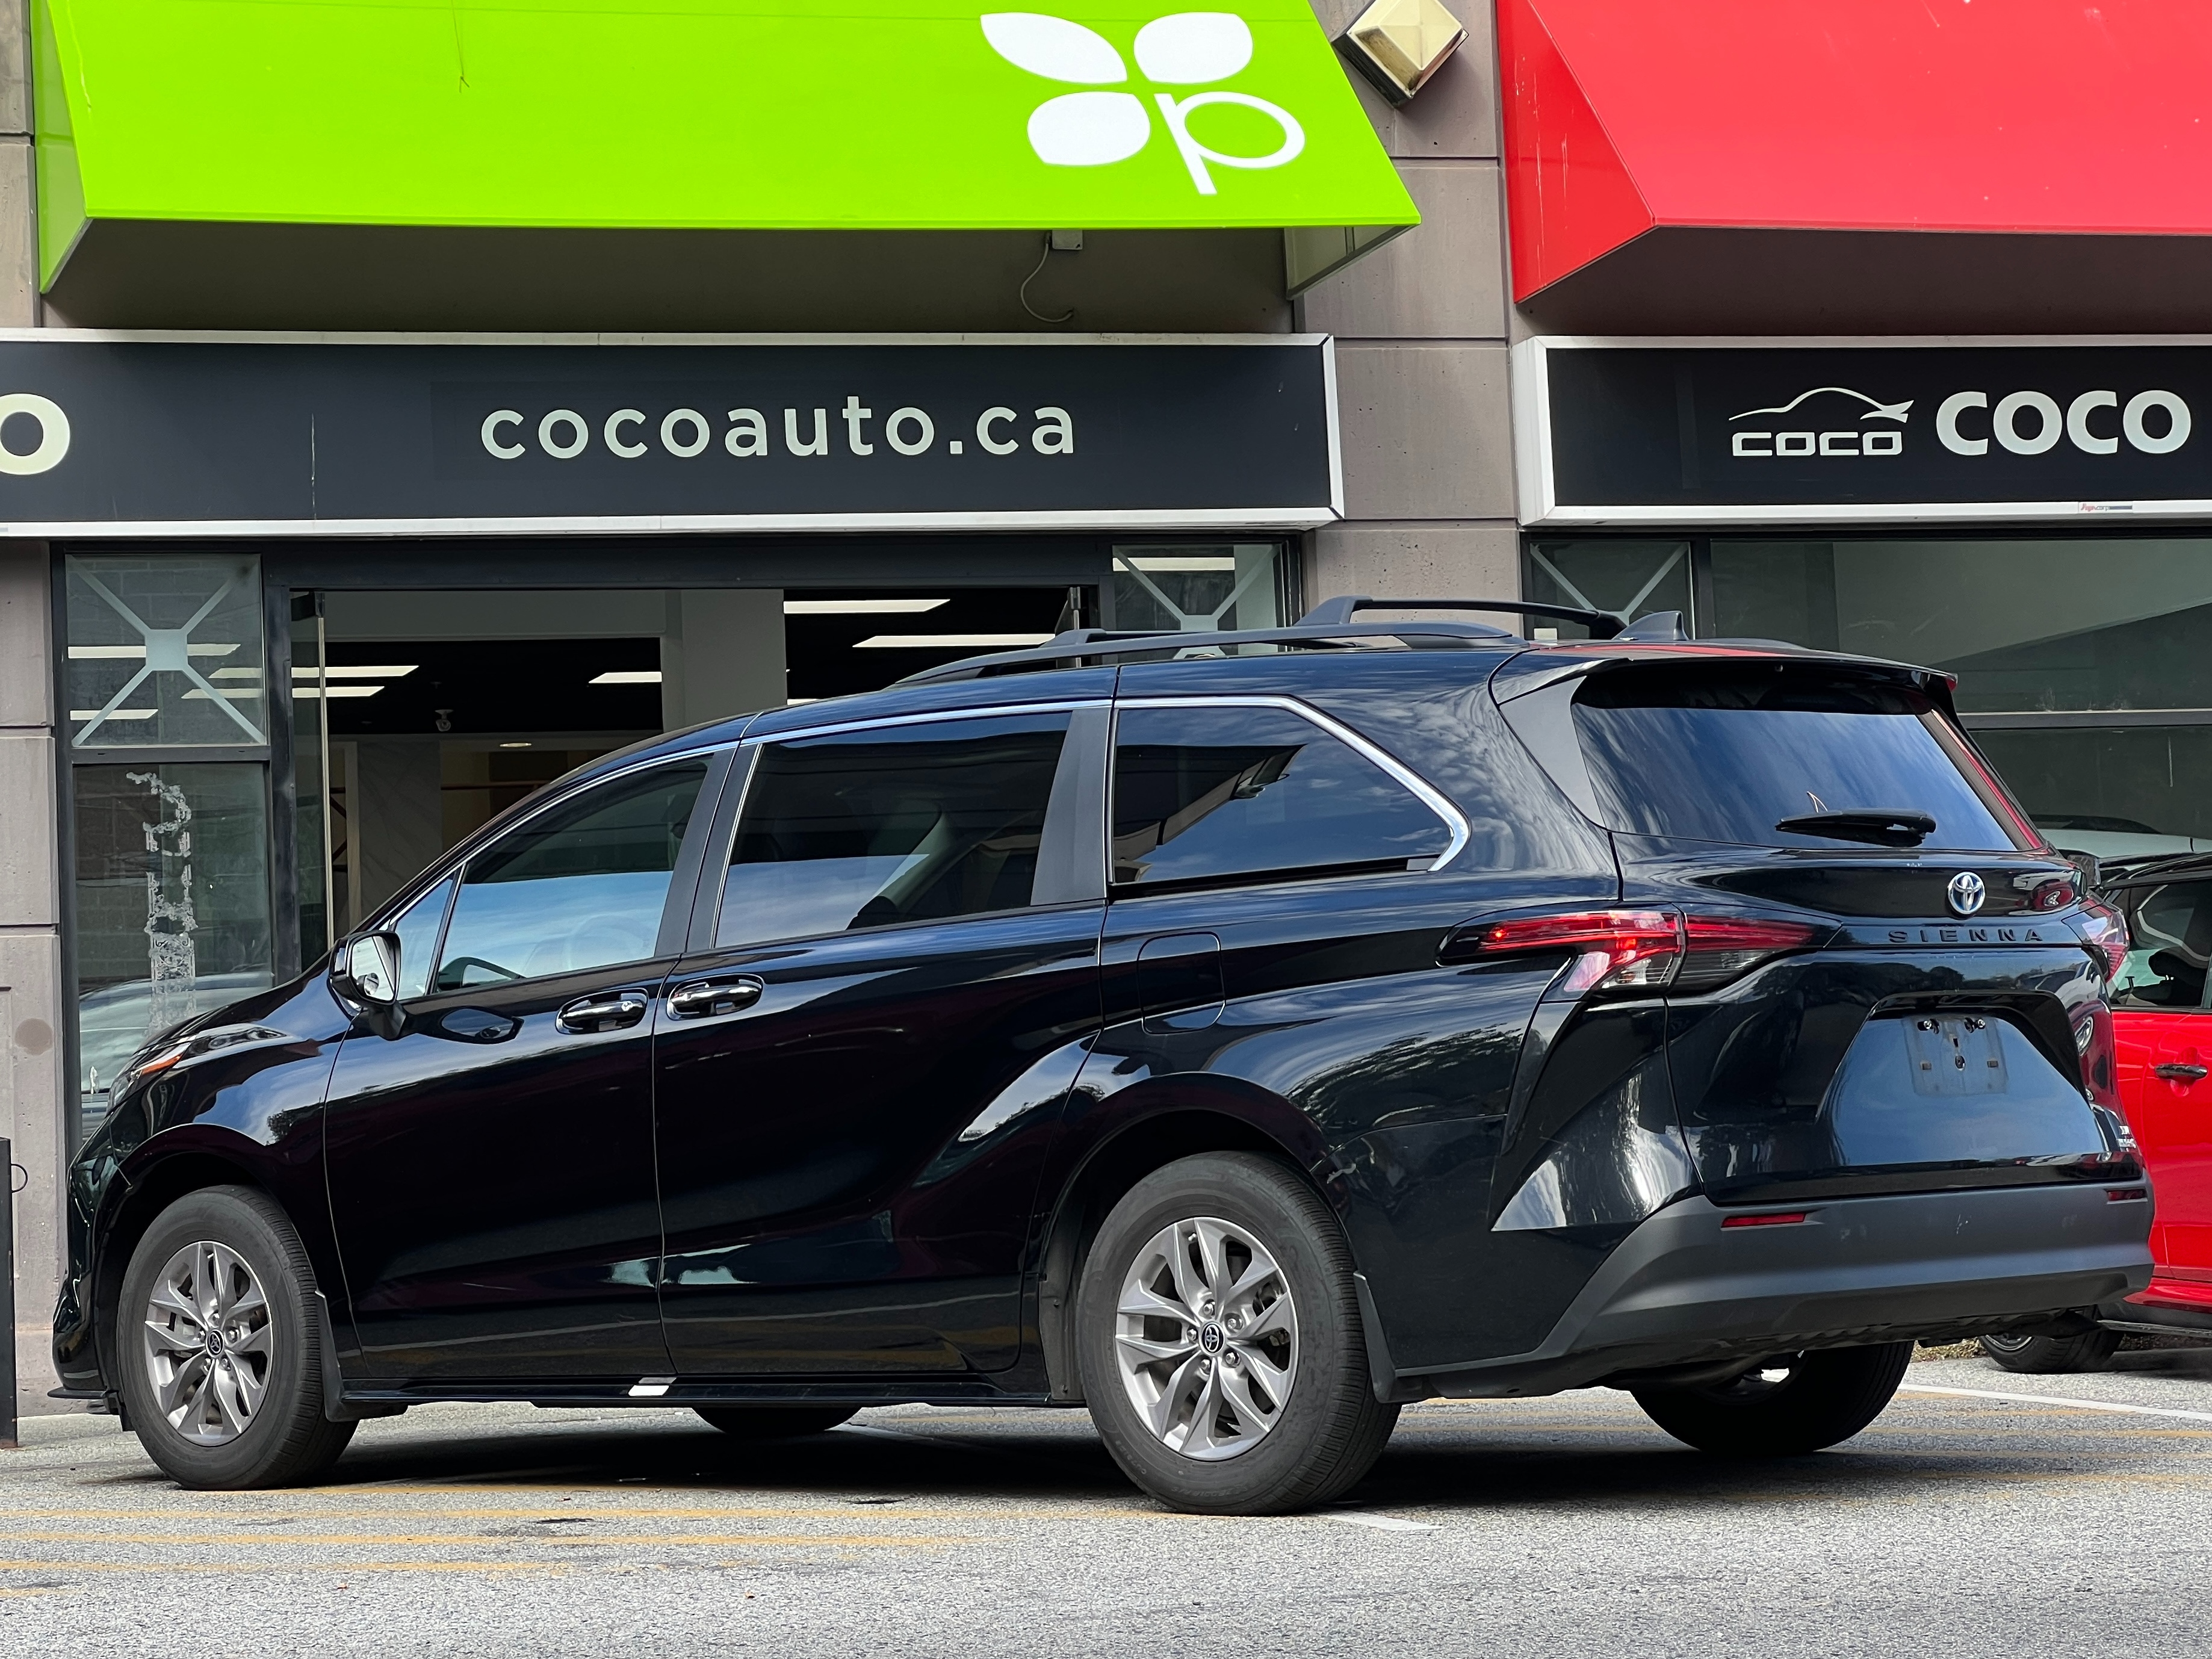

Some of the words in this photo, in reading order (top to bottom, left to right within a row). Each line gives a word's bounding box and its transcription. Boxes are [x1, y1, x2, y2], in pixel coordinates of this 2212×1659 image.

[482, 396, 1074, 459] cocoauto.ca
[1732, 432, 1903, 456] COCO
[1936, 389, 2192, 456] COCO
[1888, 929, 2043, 943] SIENNA
